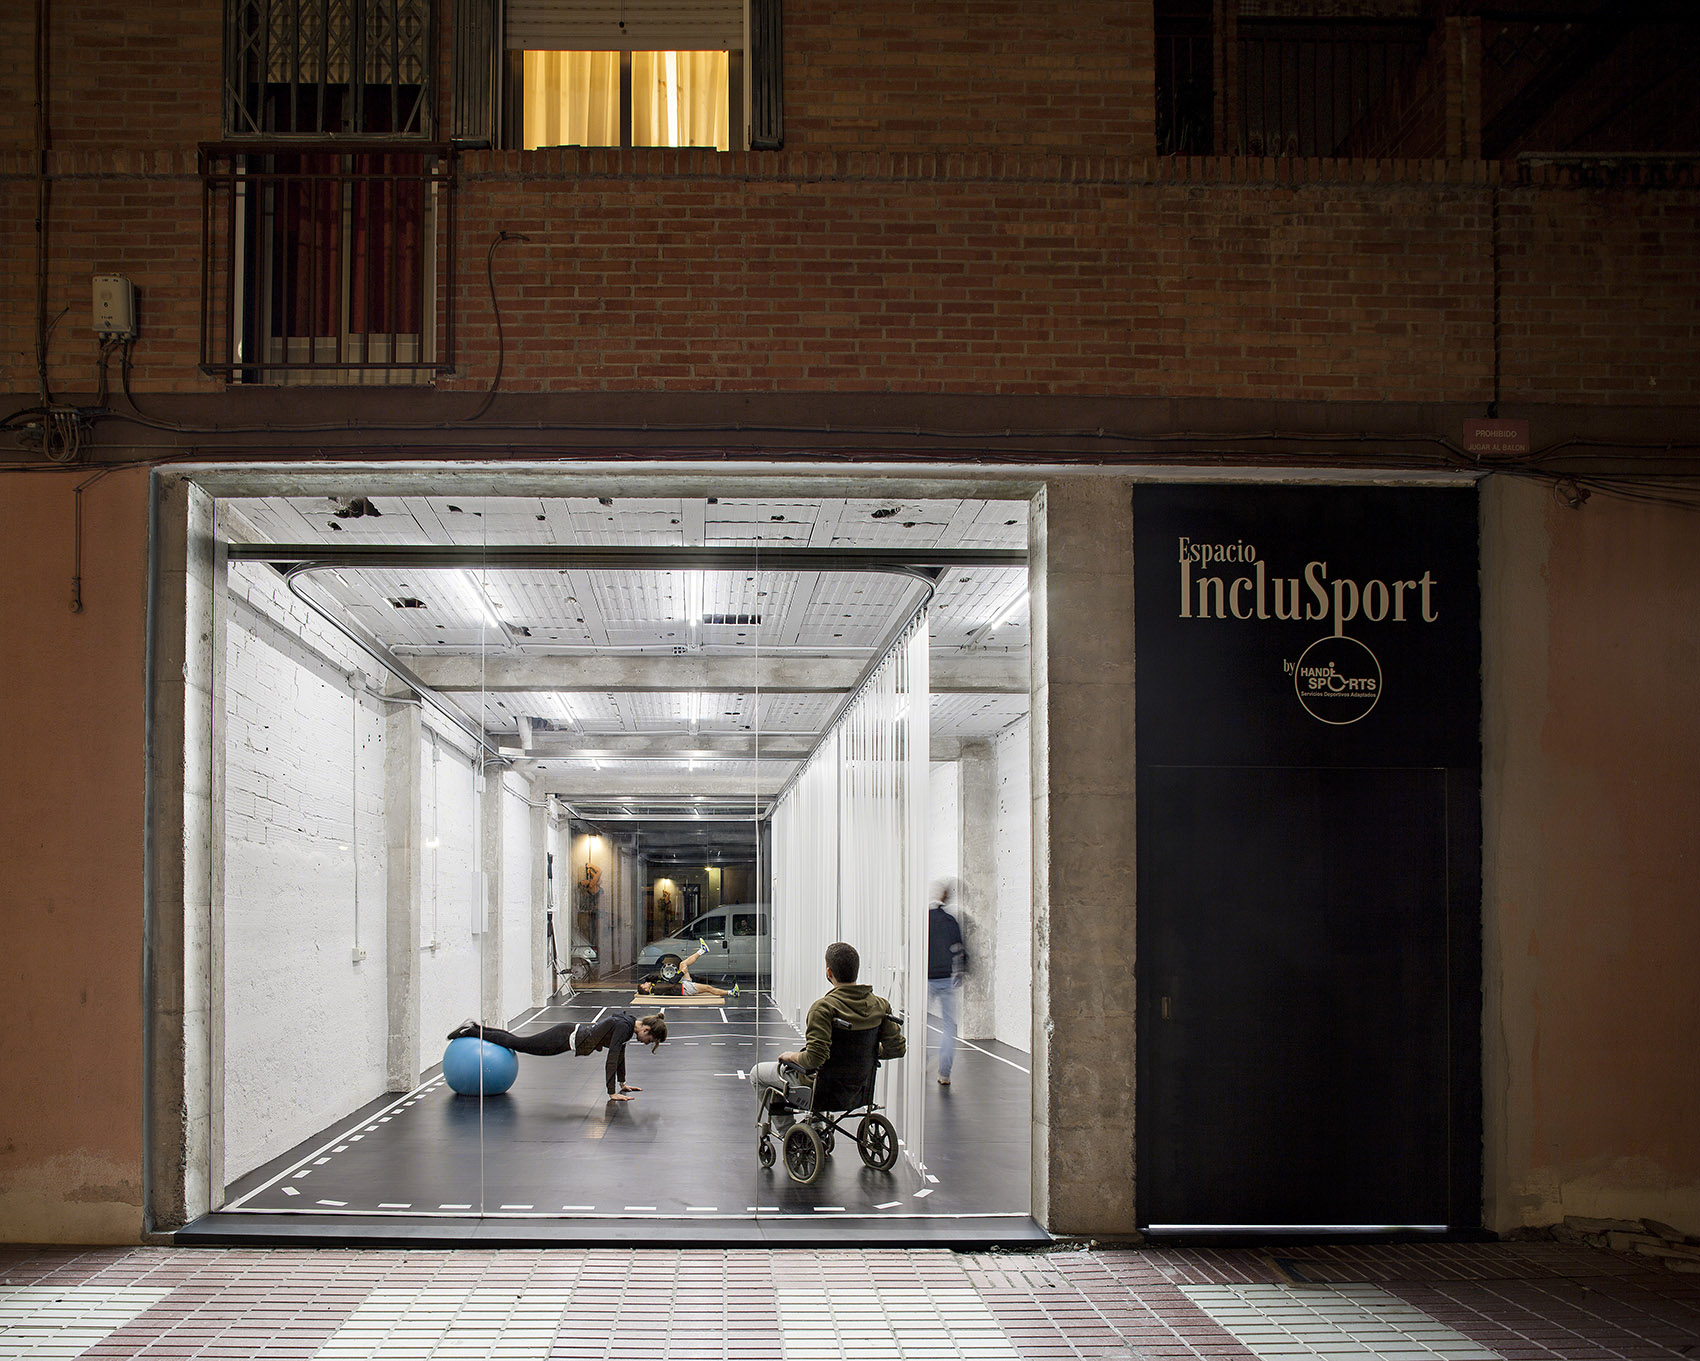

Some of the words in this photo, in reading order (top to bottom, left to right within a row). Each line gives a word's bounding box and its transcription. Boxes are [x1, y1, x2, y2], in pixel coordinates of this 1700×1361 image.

[1475, 429, 1517, 438] PROHIBIDO
[1468, 443, 1491, 451] JUGAR
[1492, 443, 1501, 451] AL
[1178, 536, 1257, 569] Espacio
[1178, 560, 1439, 636] IncluSport
[1283, 658, 1296, 676] by
[1308, 677, 1377, 692] SPORTS
